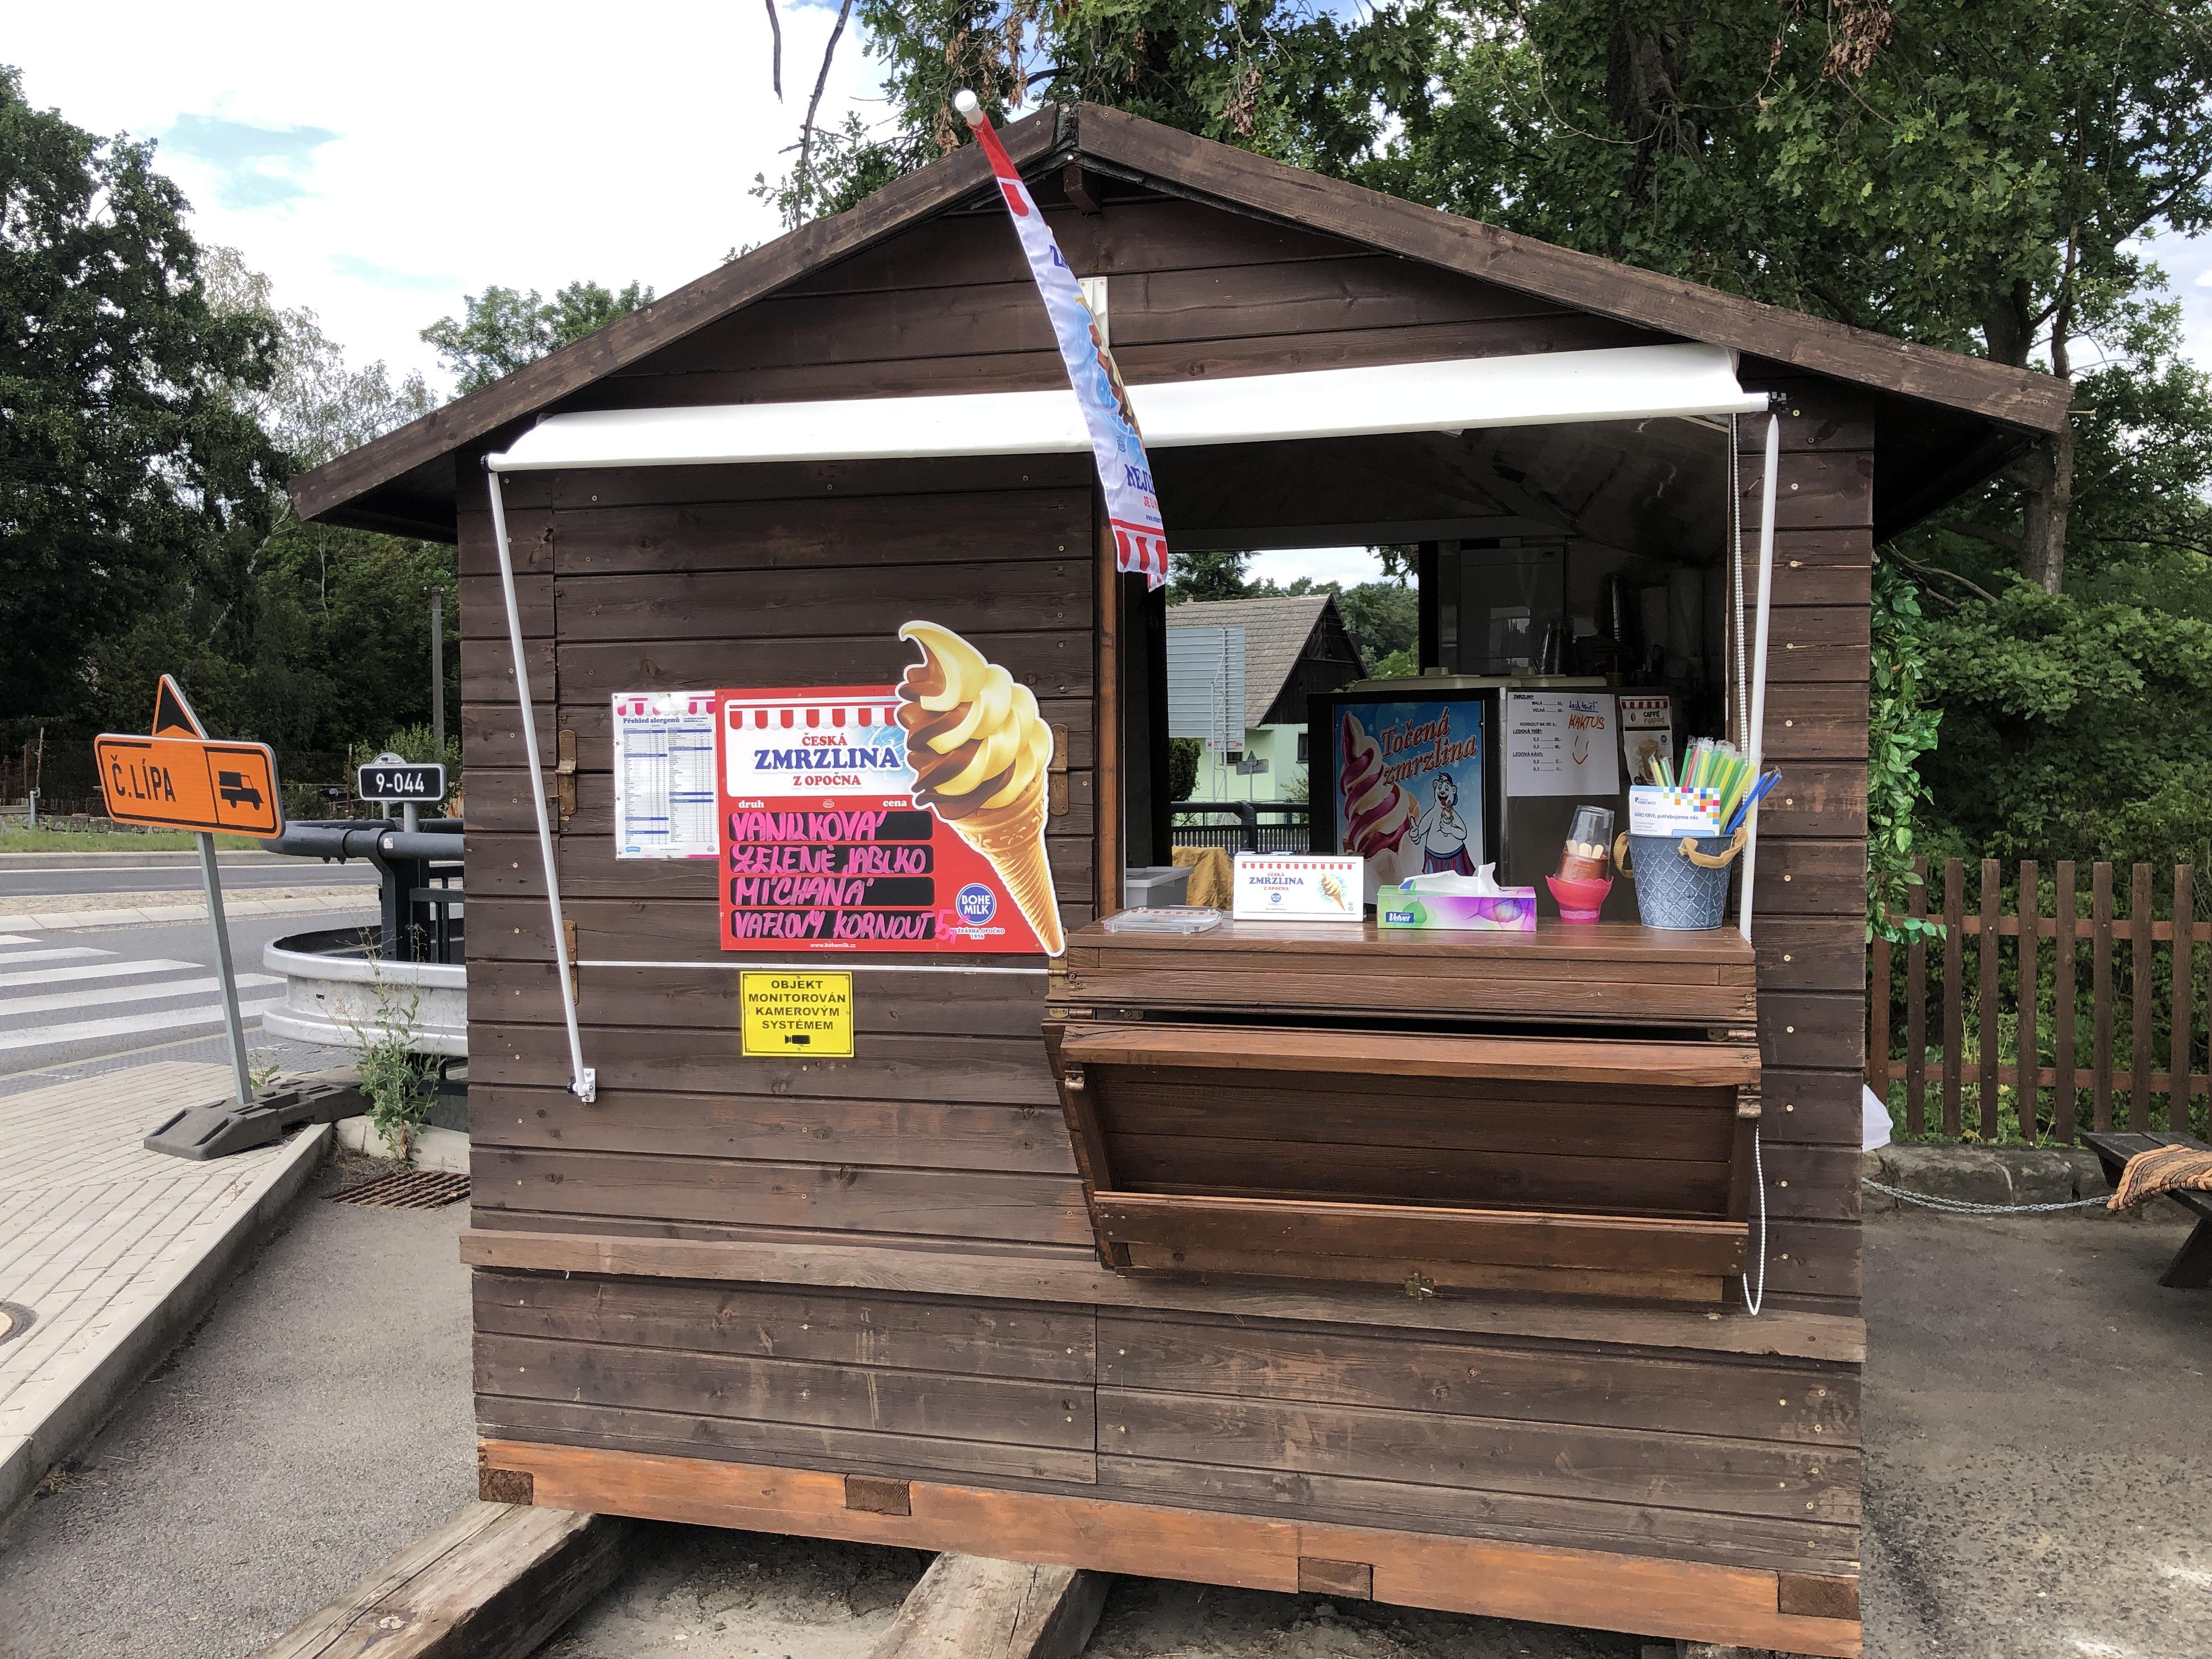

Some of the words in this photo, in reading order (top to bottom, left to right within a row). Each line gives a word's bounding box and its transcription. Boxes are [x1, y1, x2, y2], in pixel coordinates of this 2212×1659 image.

[1124, 464, 1155, 495] NEJL
[1381, 706, 1451, 757] Točená
[802, 733, 847, 746] ČESKÁ
[754, 748, 901, 769] ZMRZLINA
[1383, 735, 1476, 785] zmrzlina
[376, 773, 425, 793] 9-044
[793, 776, 802, 786] Z
[805, 772, 862, 785] OPOČNA
[962, 895, 991, 905] BOHE
[964, 905, 989, 914] MILK
[833, 910, 935, 939] KORNOUT
[771, 980, 823, 989] OBJEKT
[749, 992, 846, 1003] MONITOROVÁN
[756, 1005, 839, 1016] KAMEROVÝM
[762, 1019, 833, 1030] SYSTÉMEM
